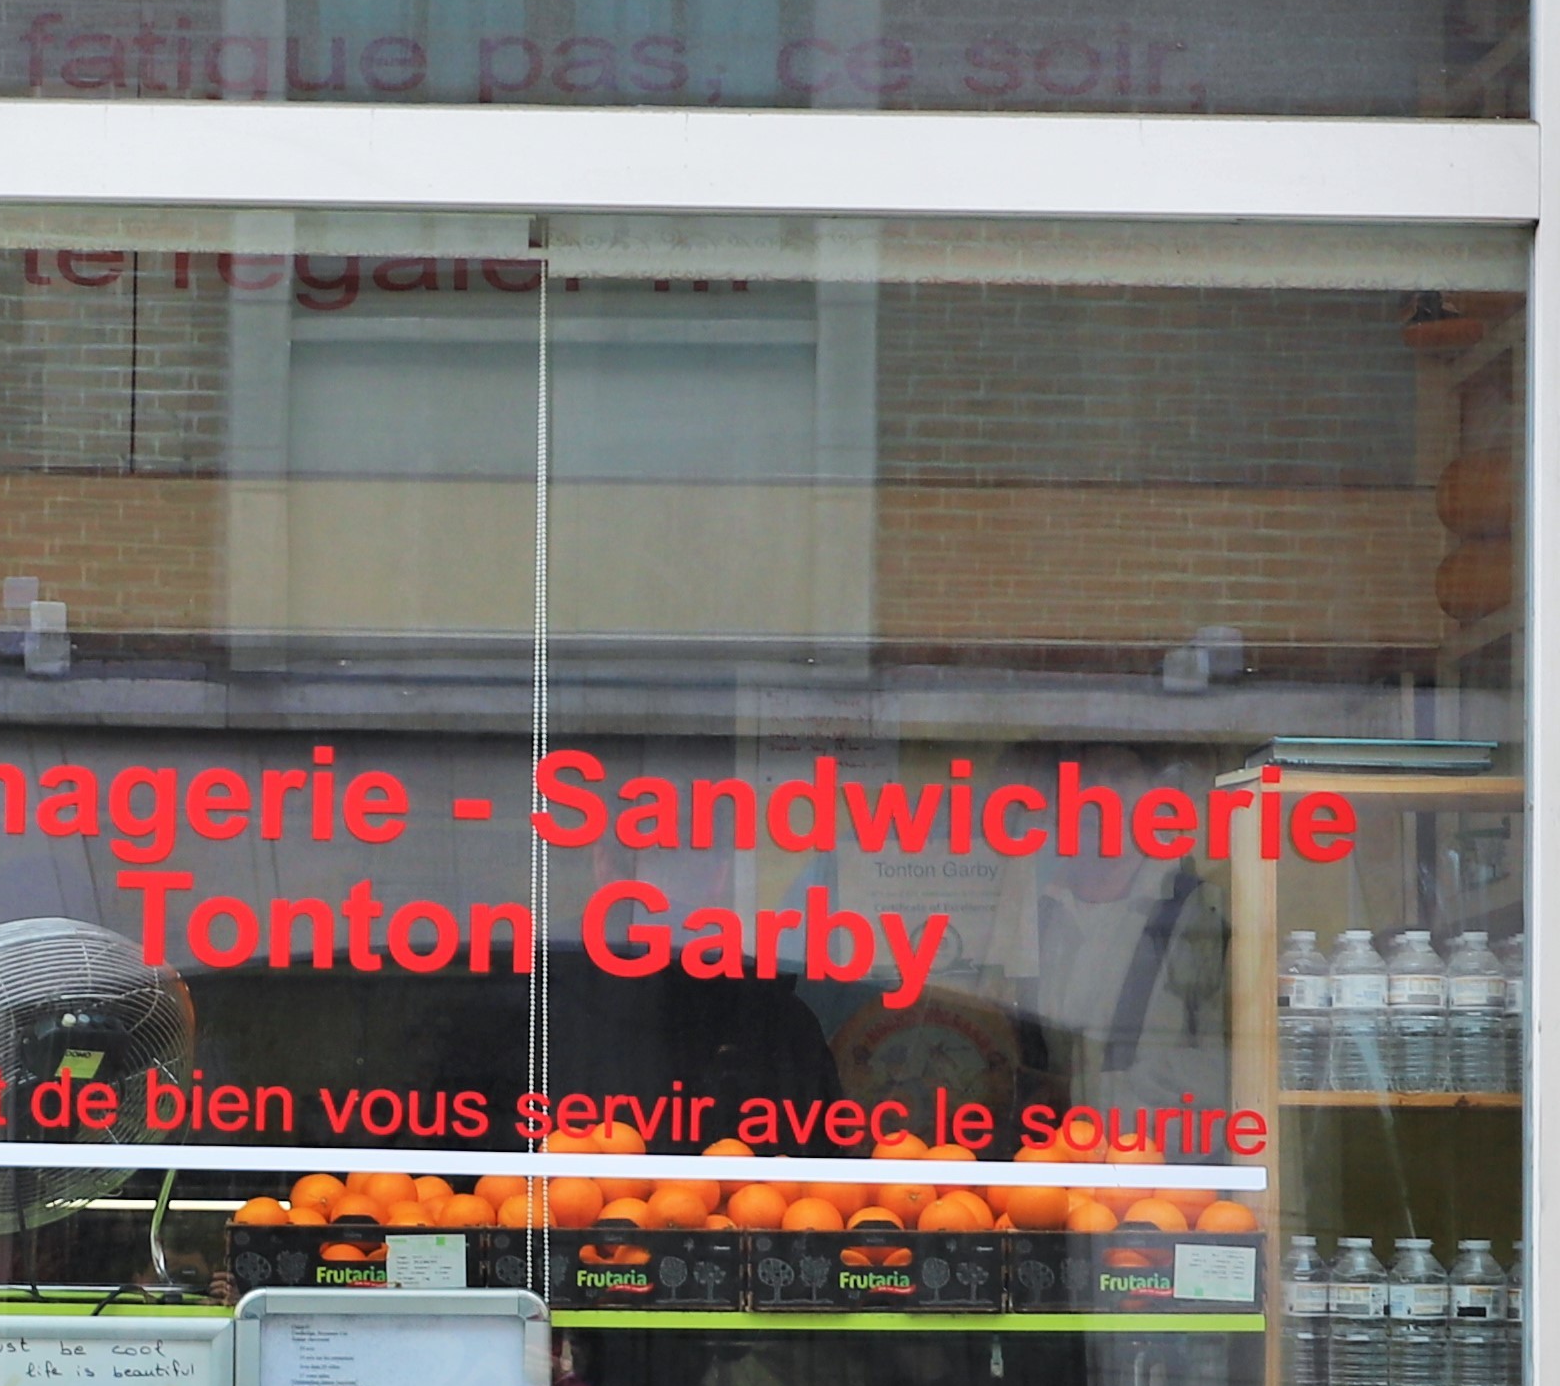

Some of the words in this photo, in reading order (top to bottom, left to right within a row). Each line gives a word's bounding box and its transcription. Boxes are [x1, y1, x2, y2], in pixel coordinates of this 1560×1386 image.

[20, 12, 427, 102] fatigue
[453, 798, 492, 819] -
[529, 750, 1357, 864] Sandwicherie
[117, 871, 531, 974] Tonton
[582, 880, 949, 1008] Garby
[30, 1067, 119, 1131] de
[146, 1068, 293, 1134] bien
[320, 1087, 488, 1139] vous
[517, 1081, 714, 1143] servir
[739, 1094, 909, 1147] avec
[935, 1087, 997, 1151] le
[1020, 1092, 1268, 1156] sourire
[316, 1265, 387, 1285] Frutaria
[577, 1269, 647, 1289] Frutaria
[839, 1270, 911, 1291] Frutaria
[1099, 1273, 1171, 1292] Frutaria
[59, 1340, 87, 1356] be
[112, 1339, 166, 1357] cool
[26, 1361, 63, 1378] life
[76, 1366, 96, 1378] is
[112, 1359, 196, 1379] beautiful
